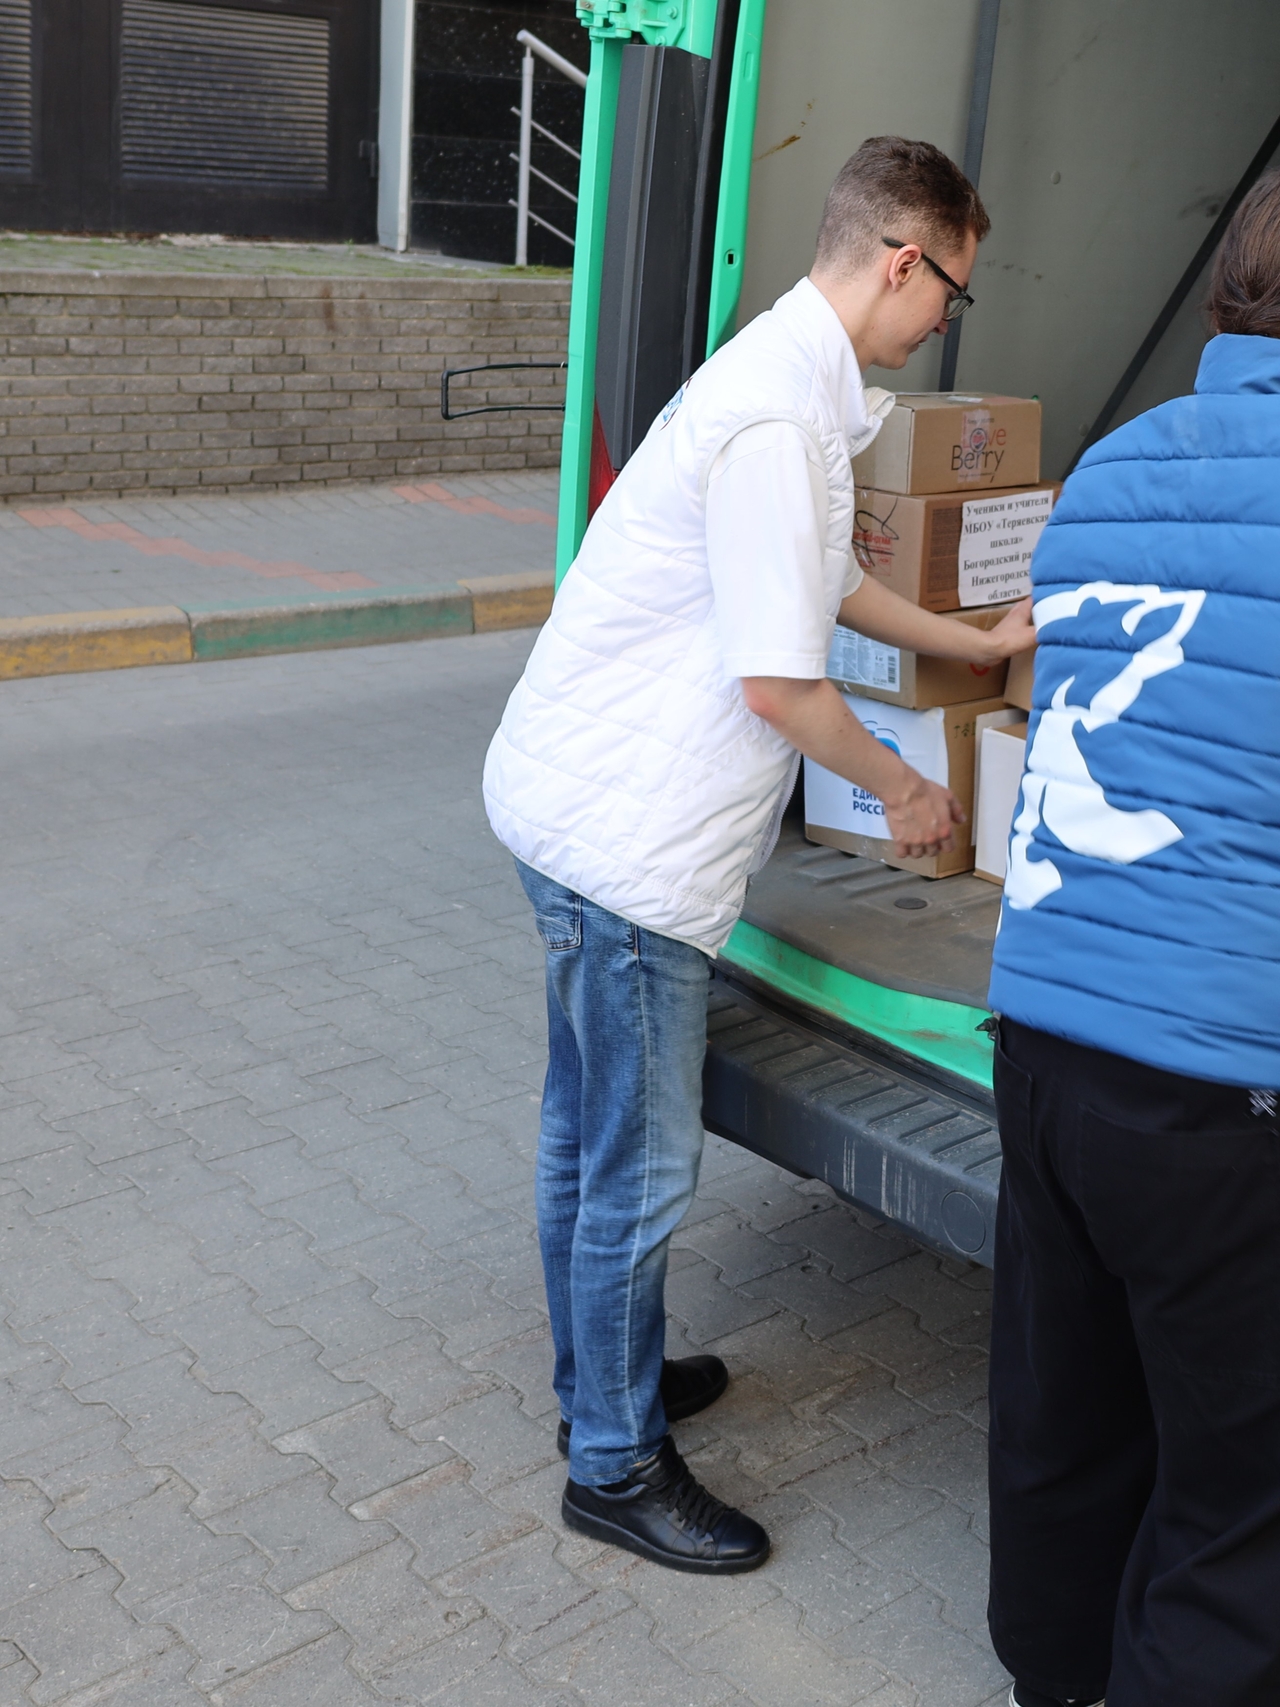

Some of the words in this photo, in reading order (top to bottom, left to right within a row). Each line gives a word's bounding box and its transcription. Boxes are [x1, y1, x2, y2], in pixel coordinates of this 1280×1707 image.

[950, 444, 1005, 484] Berry
[966, 502, 1005, 516] Ученики
[1015, 497, 1049, 512] учителя
[963, 520, 994, 535] МБОУ
[990, 536, 1024, 549] школа»
[963, 551, 1020, 570] Богородский
[1022, 551, 1032, 563] ра
[987, 588, 1022, 601] область
